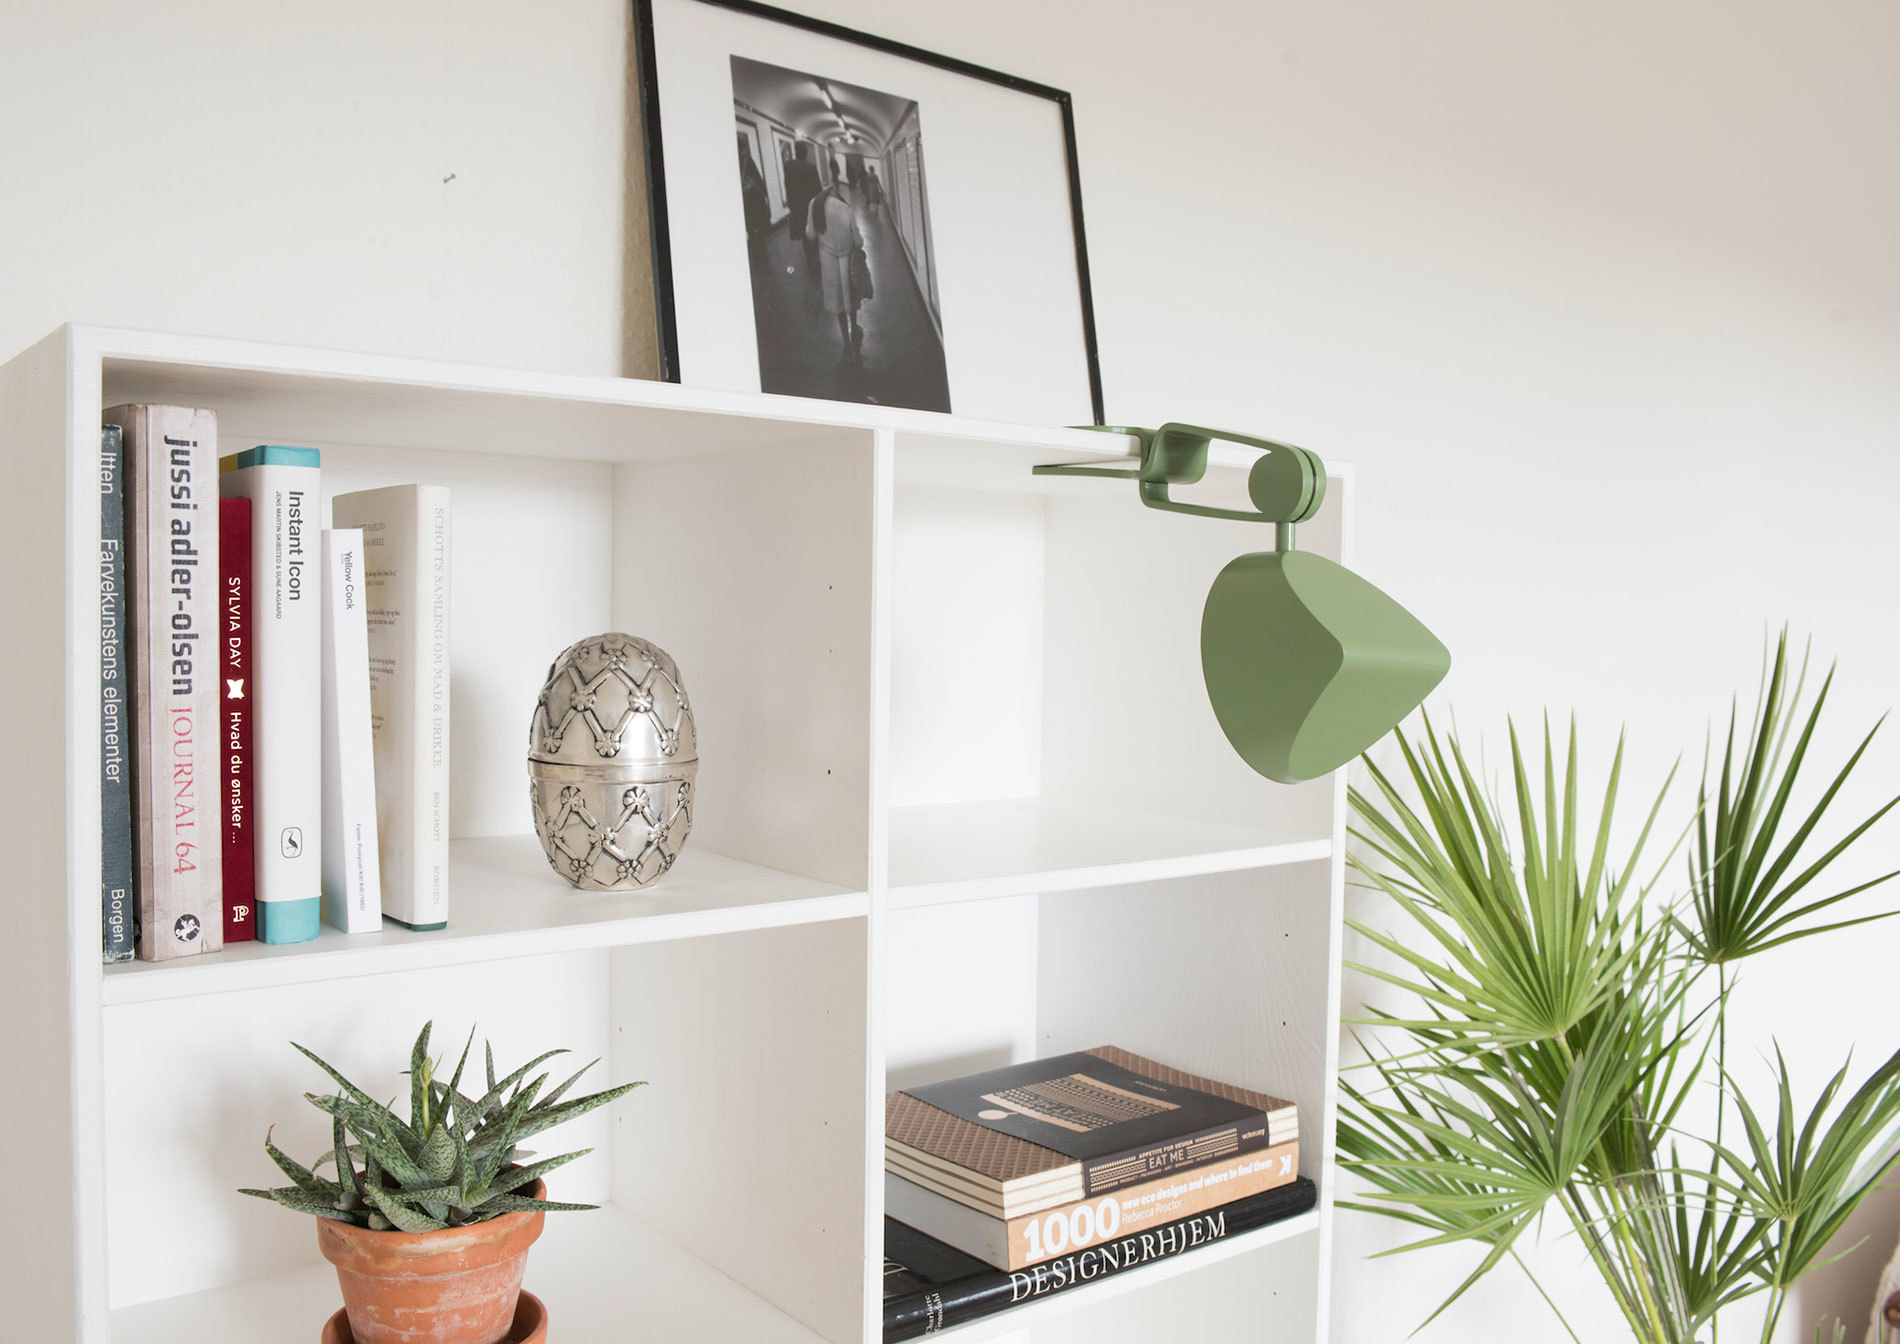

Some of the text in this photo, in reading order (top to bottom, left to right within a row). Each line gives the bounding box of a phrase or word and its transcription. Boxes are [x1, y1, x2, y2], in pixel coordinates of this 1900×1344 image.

[164, 435, 199, 696] jussi adler-olsen
[288, 490, 304, 601] Instant Icon
[433, 507, 445, 572] SCHOTTS
[344, 551, 355, 610] Yellow Cock
[101, 452, 122, 785] Itten Farvekunstens elementer
[228, 576, 242, 669] SYLVIA DAY
[433, 576, 444, 640] SAMLING
[433, 643, 443, 664] OM
[432, 668, 443, 700] MAD
[230, 712, 243, 750] Hvad
[432, 717, 443, 768] DRIKKE
[170, 706, 199, 875] JOURNAL 64
[230, 755, 243, 774] du
[231, 779, 244, 828] ønsker
[433, 809, 441, 845] SCHOTT
[433, 865, 441, 905] BORGEN
[109, 888, 126, 944] Borgen
[1138, 1147, 1163, 1159] APPETITE
[1174, 1139, 1193, 1150] DESIGN
[1149, 1149, 1185, 1169] EAT ME
[1122, 1159, 1273, 1211] new eco designs and where to find them
[1024, 1197, 1120, 1263] 1000
[1121, 1198, 1183, 1225] Rebecca Proctor
[1009, 1212, 1227, 1302] DESIGNERHJEM
